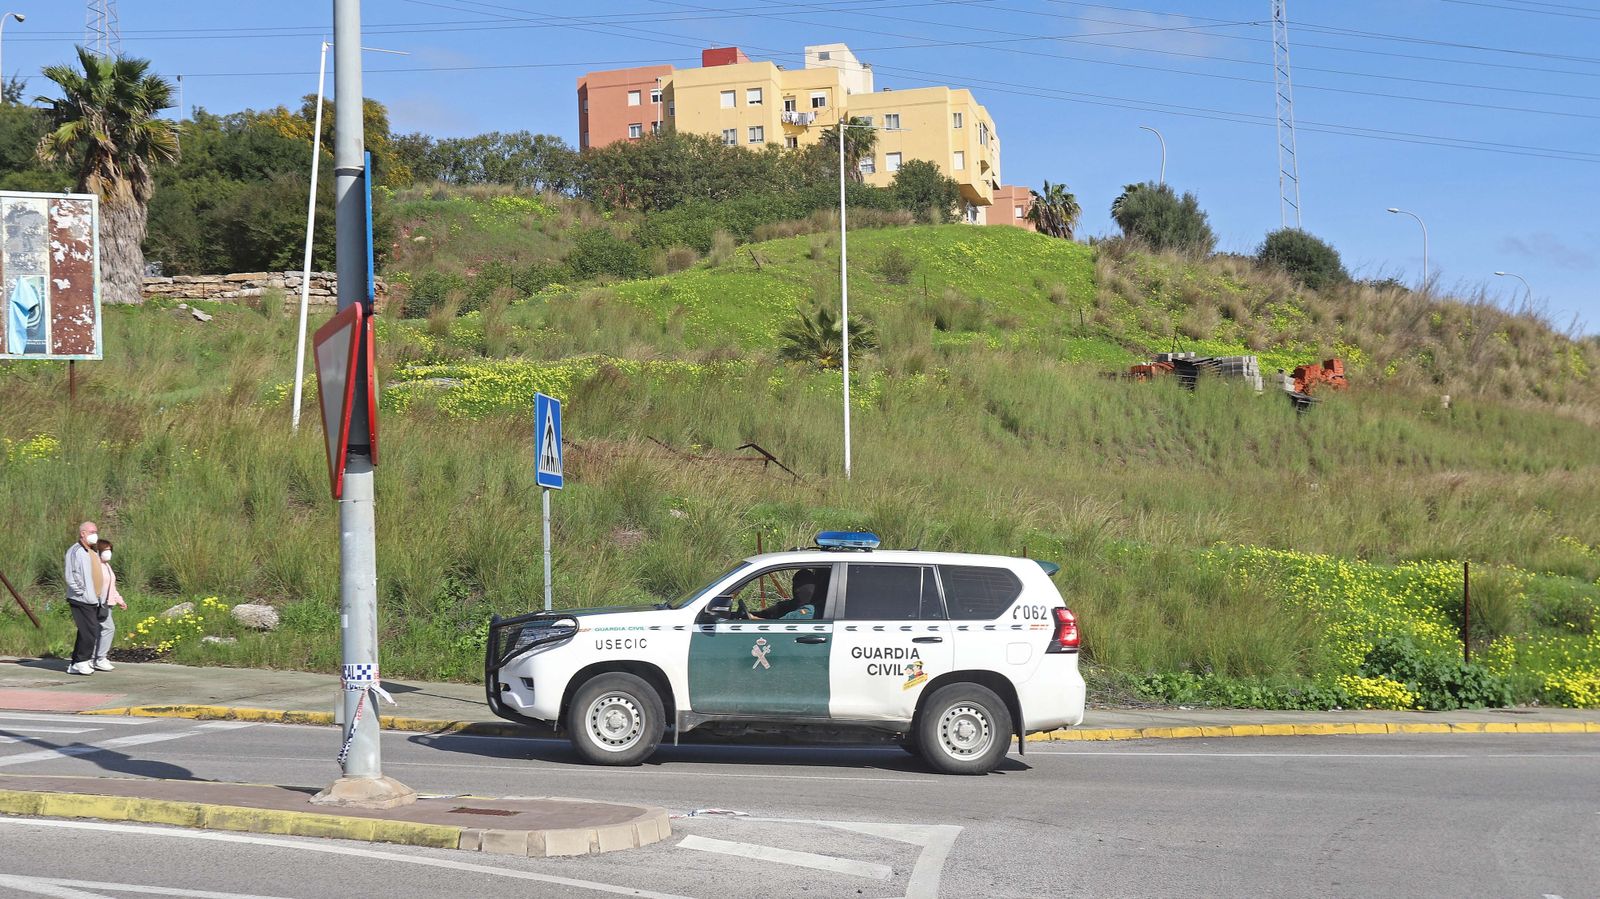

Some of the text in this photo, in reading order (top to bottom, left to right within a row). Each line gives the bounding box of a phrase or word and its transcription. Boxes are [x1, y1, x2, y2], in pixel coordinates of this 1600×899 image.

[1023, 605, 1047, 620] 062
[595, 638, 647, 650] USECIC
[851, 646, 920, 660] GUARDIA
[867, 663, 904, 676] CIVIL
